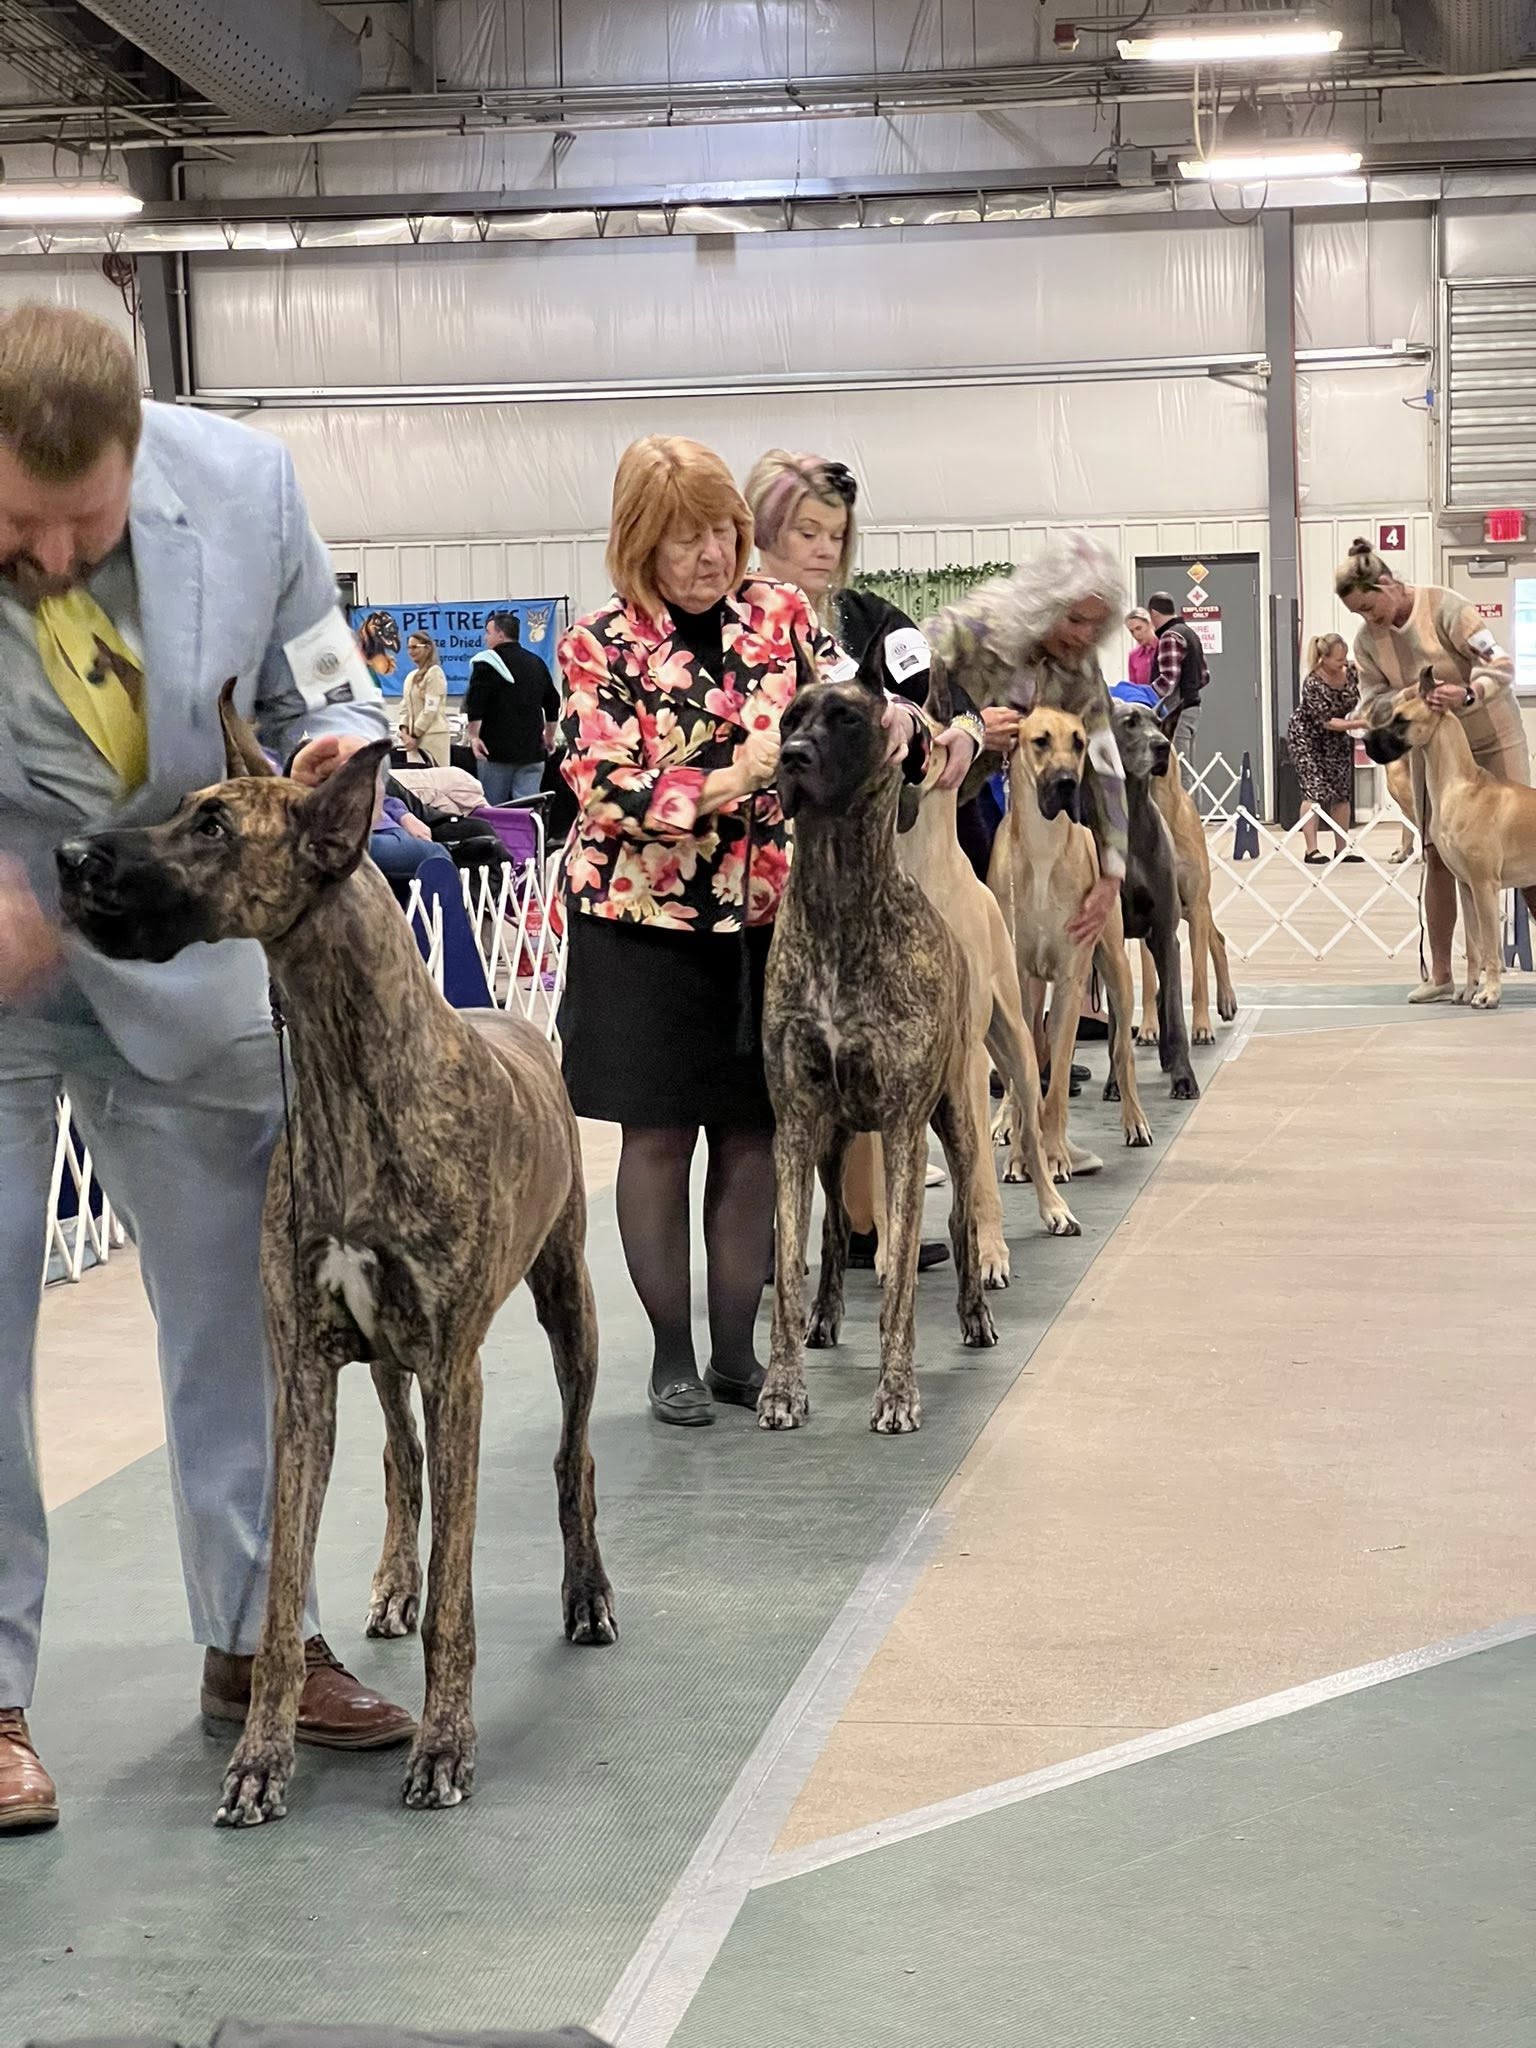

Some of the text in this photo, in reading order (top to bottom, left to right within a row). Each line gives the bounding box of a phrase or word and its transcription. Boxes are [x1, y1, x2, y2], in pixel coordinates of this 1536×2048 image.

[1386, 528, 1399, 546] 4
[403, 609, 519, 631] PET TRE
[450, 635, 482, 648] Dried
